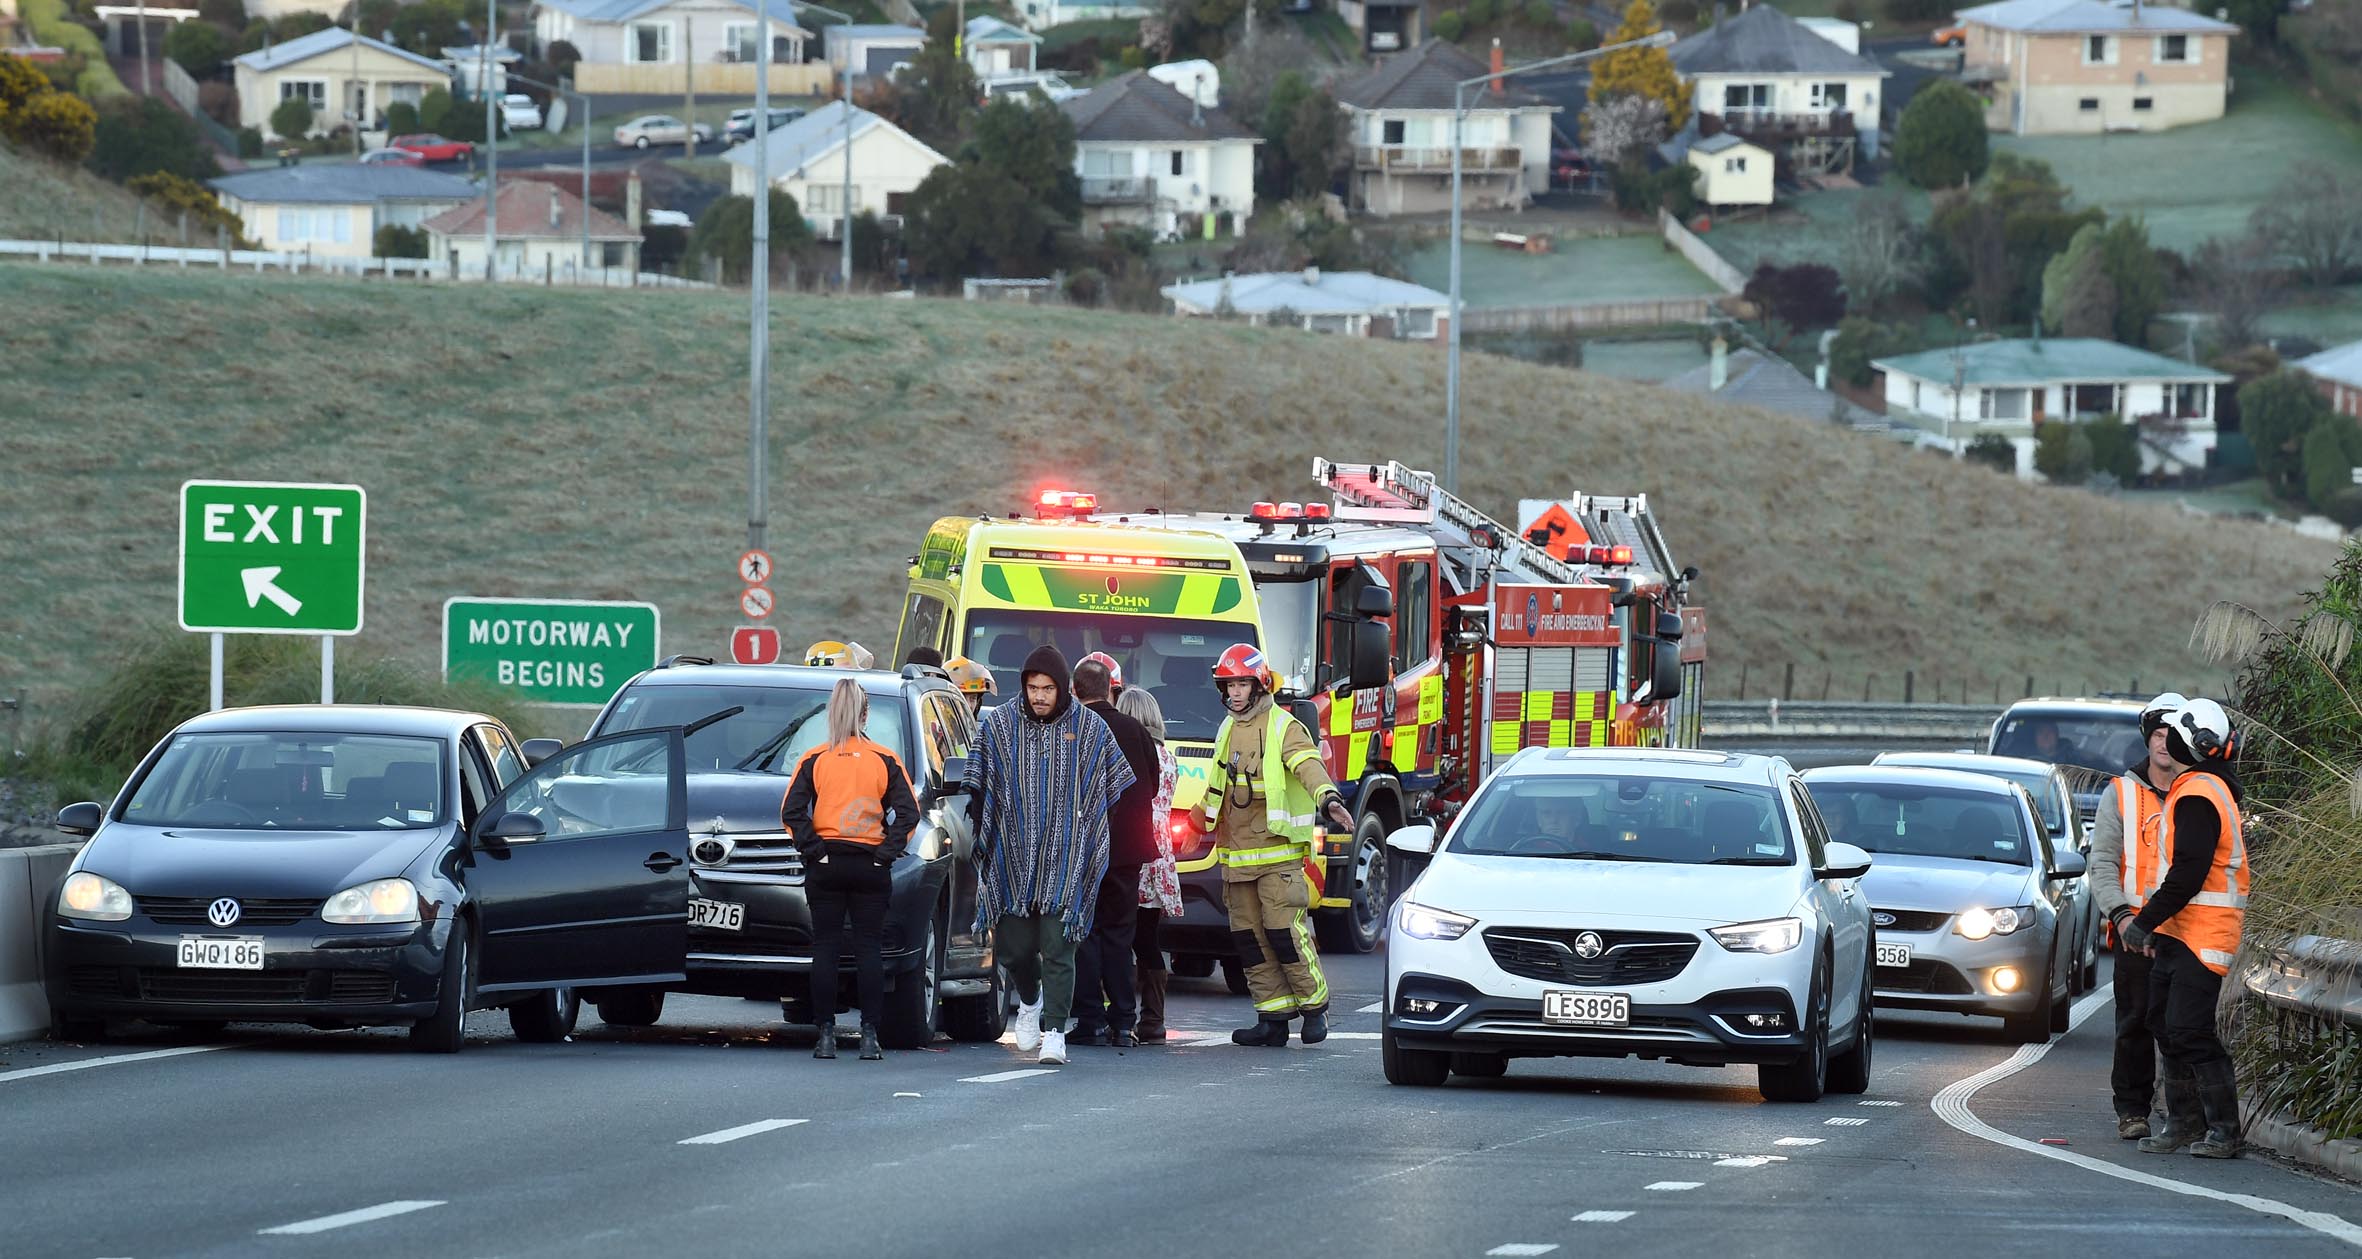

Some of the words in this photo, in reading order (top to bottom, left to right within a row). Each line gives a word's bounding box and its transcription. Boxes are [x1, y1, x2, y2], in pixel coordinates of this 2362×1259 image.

[203, 503, 342, 545] EXIT
[1078, 593, 1099, 604] ST
[1103, 595, 1149, 607] JOHN
[468, 618, 635, 648] MOTORWAY
[1501, 613, 1514, 630] CALL
[1515, 614, 1523, 630] 111
[1542, 614, 1553, 630] FIRE
[1554, 614, 1565, 631] AND
[748, 633, 761, 661] 1
[498, 659, 605, 688] BEGINS
[1355, 687, 1380, 715] FIRE
[688, 903, 740, 927] DR716
[182, 943, 260, 965] GWQ186
[1877, 947, 1907, 964] 358
[1546, 996, 1625, 1020] LES896
